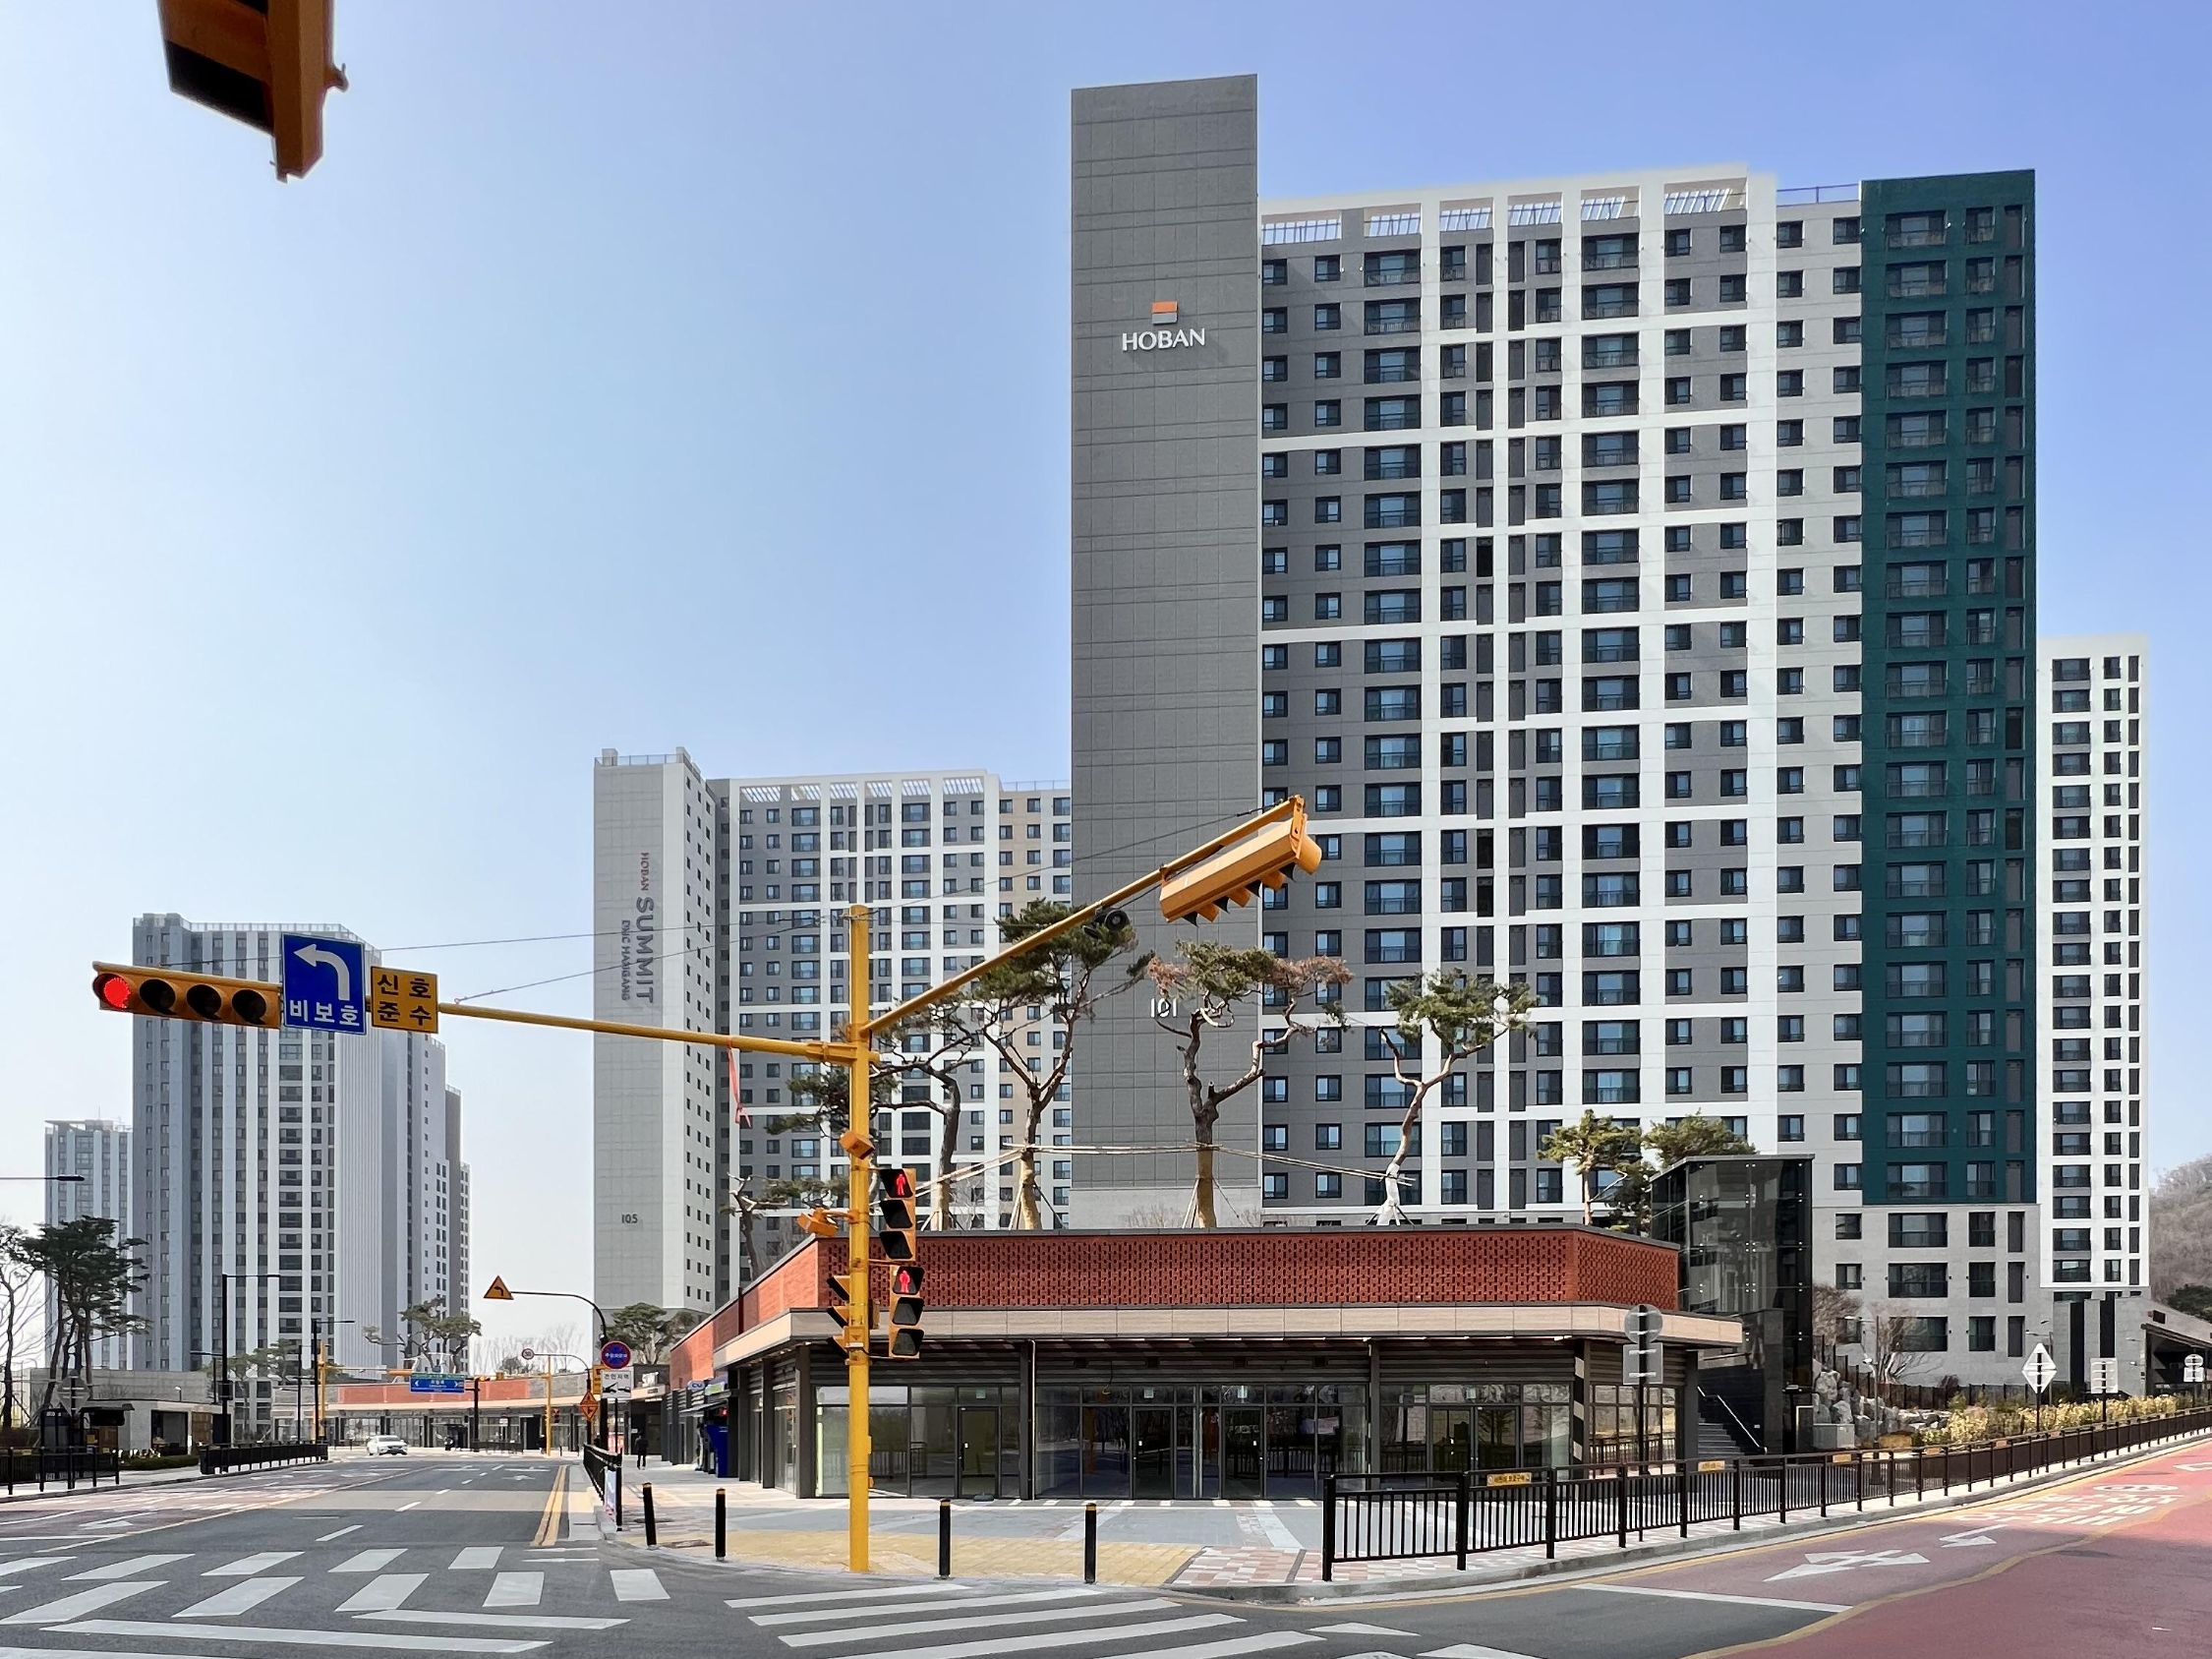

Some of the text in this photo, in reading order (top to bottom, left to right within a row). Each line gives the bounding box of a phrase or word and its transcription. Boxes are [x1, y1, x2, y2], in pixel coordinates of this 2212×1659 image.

[1122, 328, 1205, 351] HOBAN
[636, 852, 655, 1003] HOBAN SUMMIT
[621, 946, 631, 1001] HANGANG
[378, 974, 432, 998] 신호
[289, 999, 360, 1027] 비보호
[378, 1001, 433, 1026] 준수
[1150, 997, 1177, 1018] 101
[621, 1214, 638, 1223] 105
